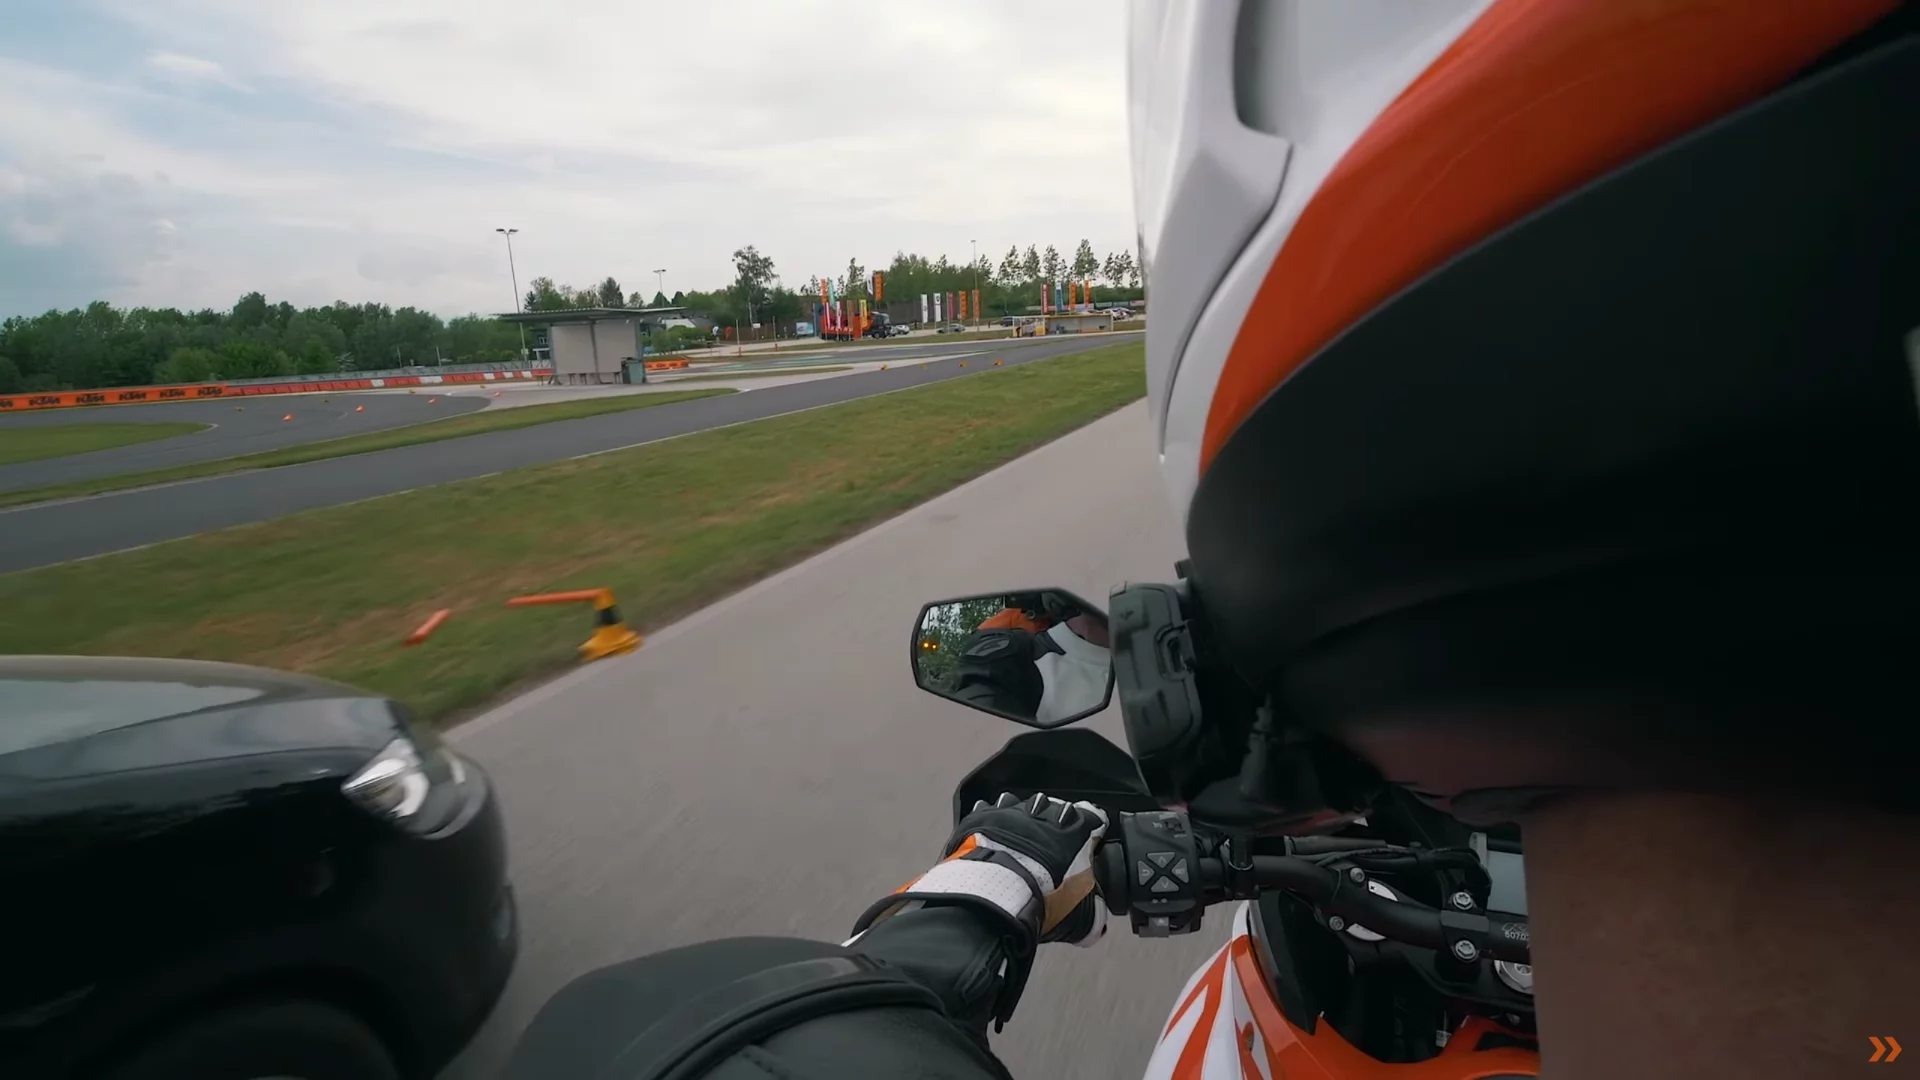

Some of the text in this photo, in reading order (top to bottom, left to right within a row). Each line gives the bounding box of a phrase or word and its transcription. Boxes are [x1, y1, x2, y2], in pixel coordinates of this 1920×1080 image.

[29, 396, 60, 406] KTM
[76, 393, 105, 404] KTM
[119, 391, 147, 401] KTM
